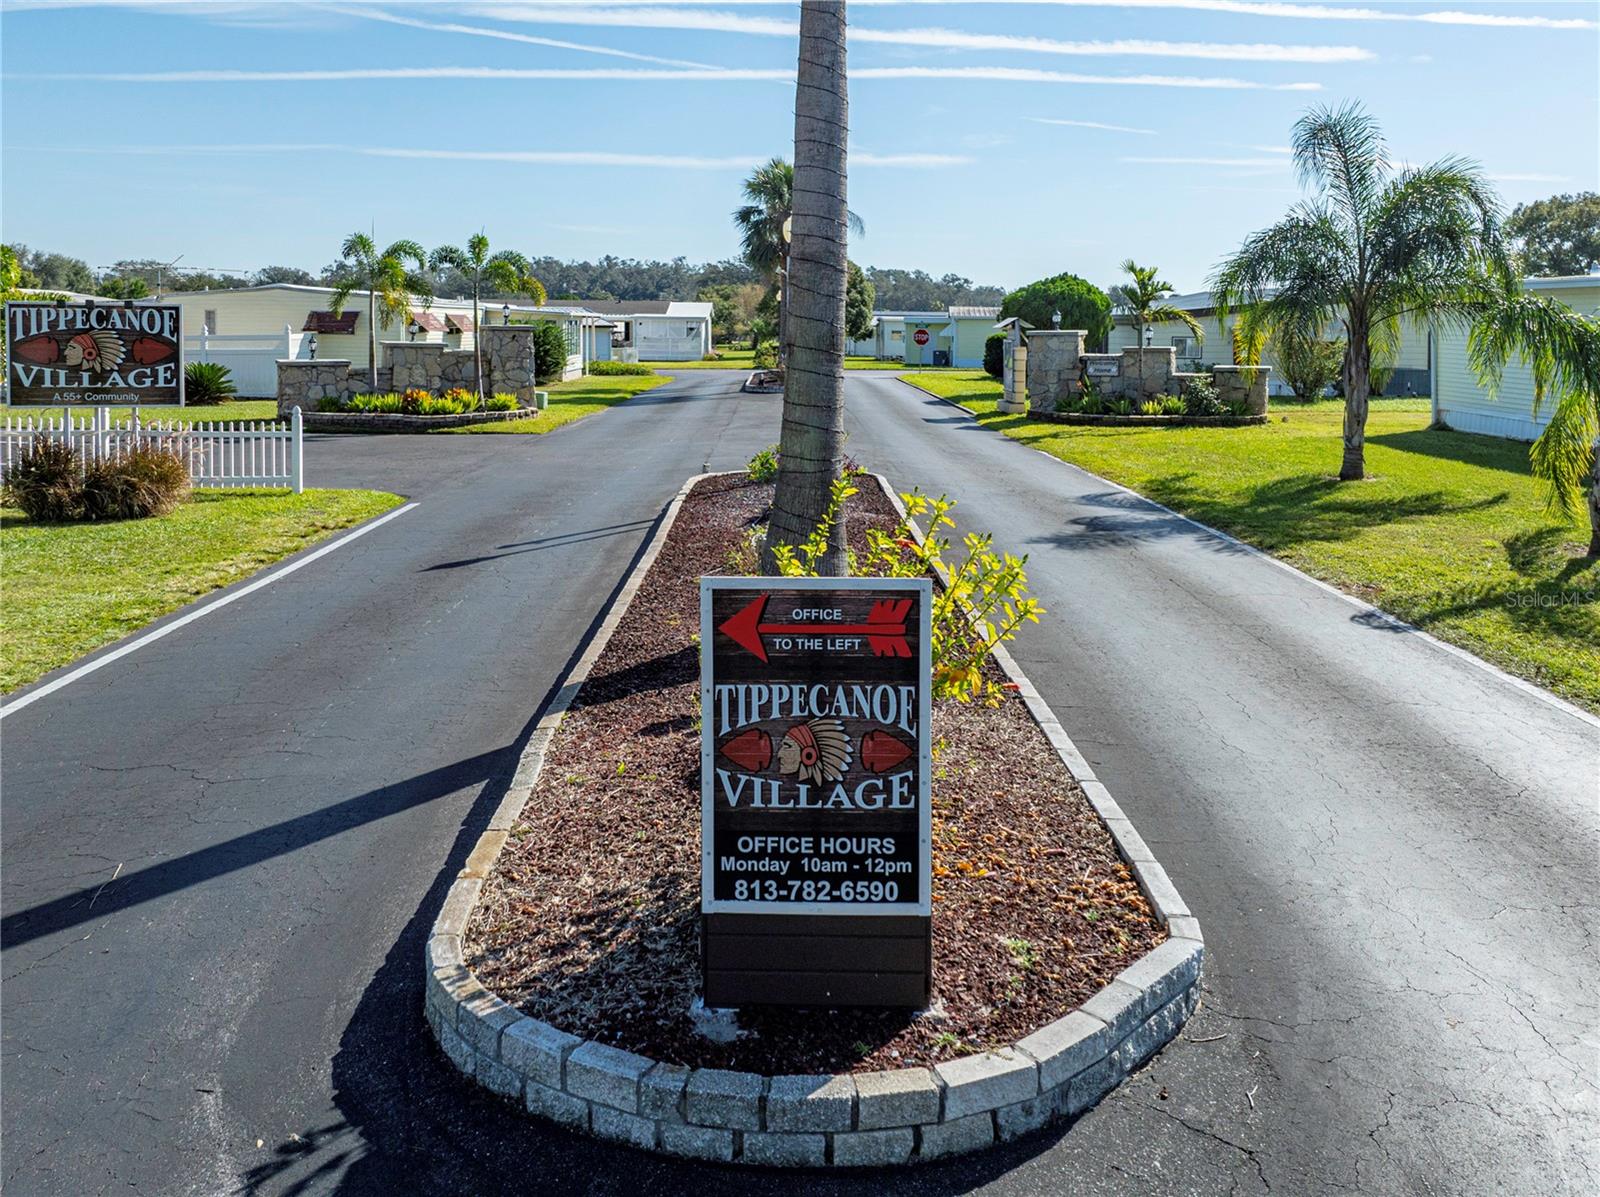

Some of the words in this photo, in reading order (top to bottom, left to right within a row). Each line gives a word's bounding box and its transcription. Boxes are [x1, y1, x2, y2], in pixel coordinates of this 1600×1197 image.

[10, 307, 178, 343] TIPPECANOE
[913, 333, 929, 341] STOP
[12, 361, 177, 388] VILLAGE
[53, 392, 61, 401] A
[63, 392, 82, 401] 55+
[84, 392, 140, 402] Community
[792, 608, 842, 621] OFFICE
[773, 638, 792, 650] TO
[796, 638, 823, 650] THE
[827, 638, 861, 650] LEFT
[715, 683, 917, 739] TIPPECANOE
[716, 767, 915, 810] VILLAGE
[737, 836, 814, 854] OFFICE
[820, 837, 896, 855] HOURS
[720, 856, 791, 875] Monday
[801, 857, 847, 873] 10am
[865, 858, 912, 876] 12pm
[734, 879, 899, 902] 813-782-6590
